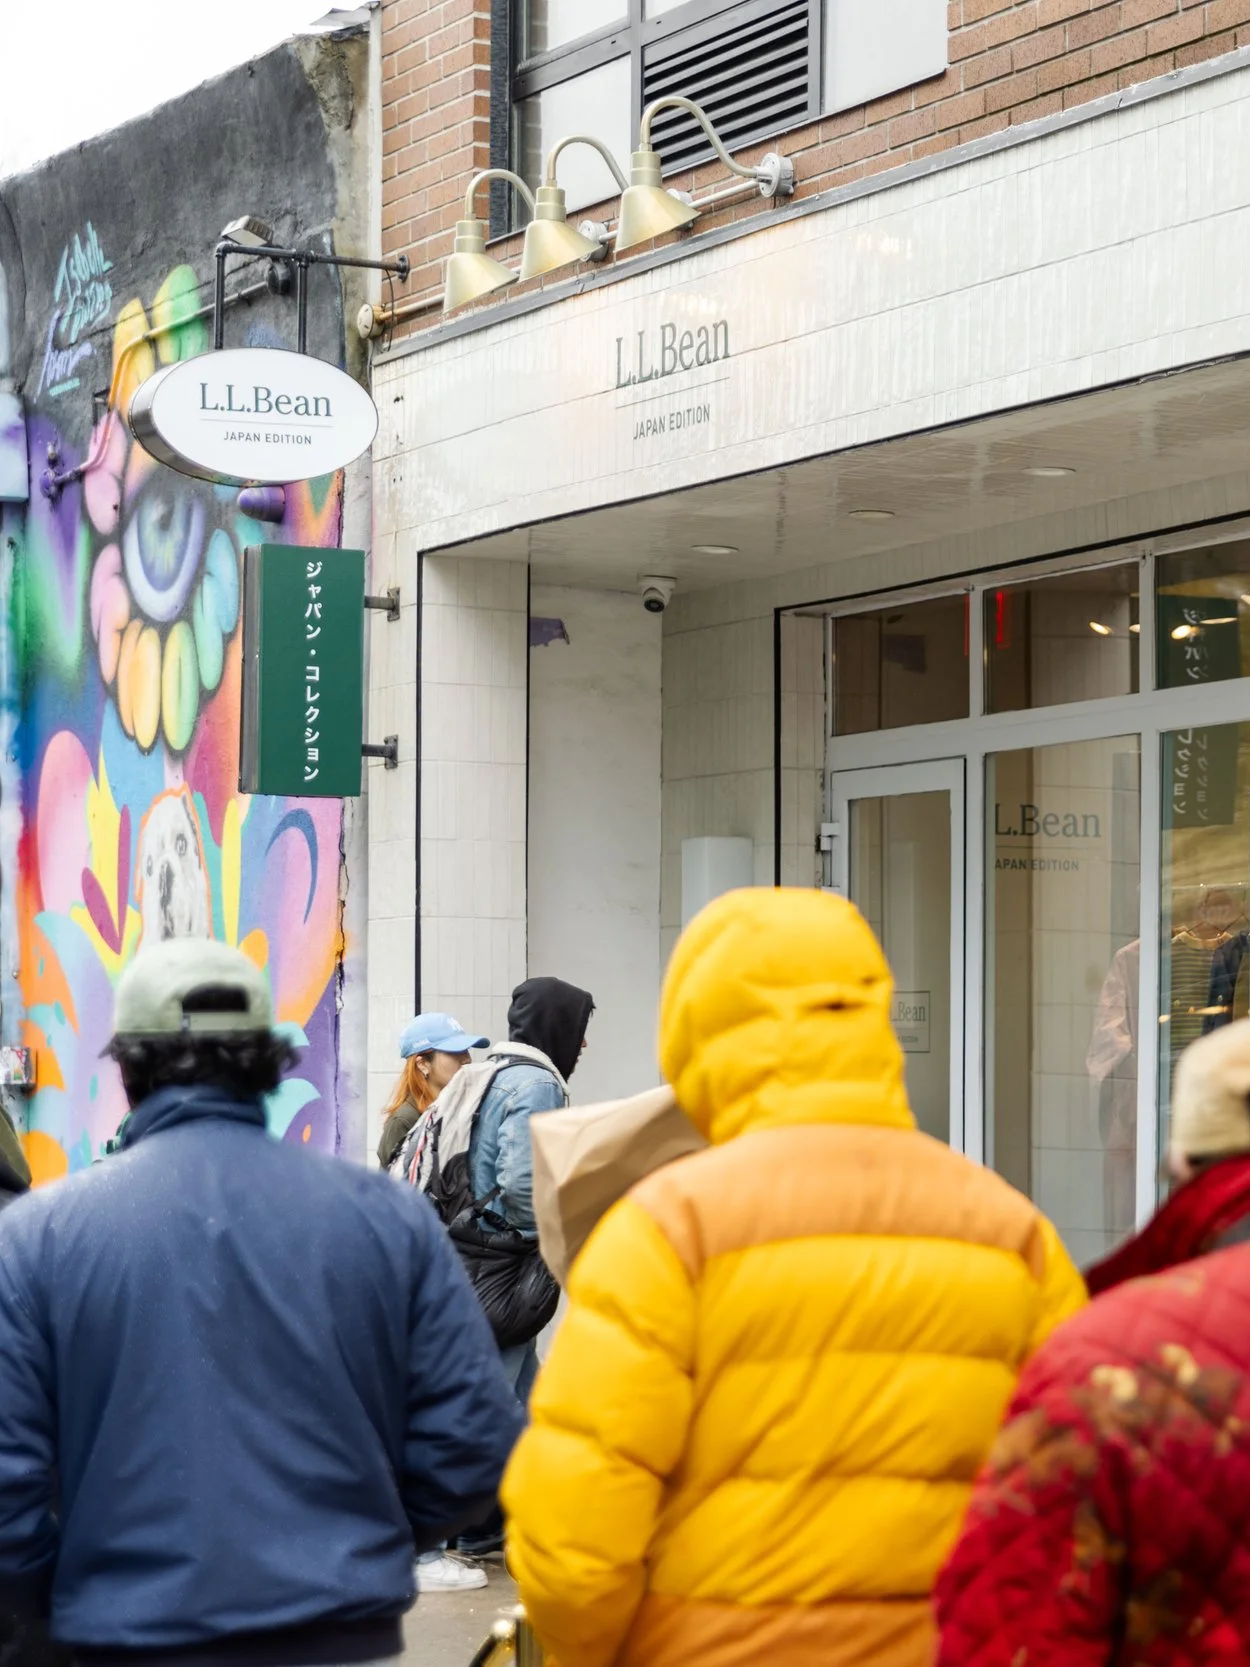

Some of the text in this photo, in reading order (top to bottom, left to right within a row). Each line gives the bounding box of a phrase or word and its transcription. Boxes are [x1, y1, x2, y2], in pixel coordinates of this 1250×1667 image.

[614, 318, 731, 390] L.L.Bean
[199, 382, 333, 417] L.L.Bean
[223, 431, 312, 445] JAPAN EDITION
[633, 403, 711, 440] JAPAN EDITION
[304, 560, 323, 782] ジャパン・コレクション
[995, 858, 1079, 872] APAN EDITION
